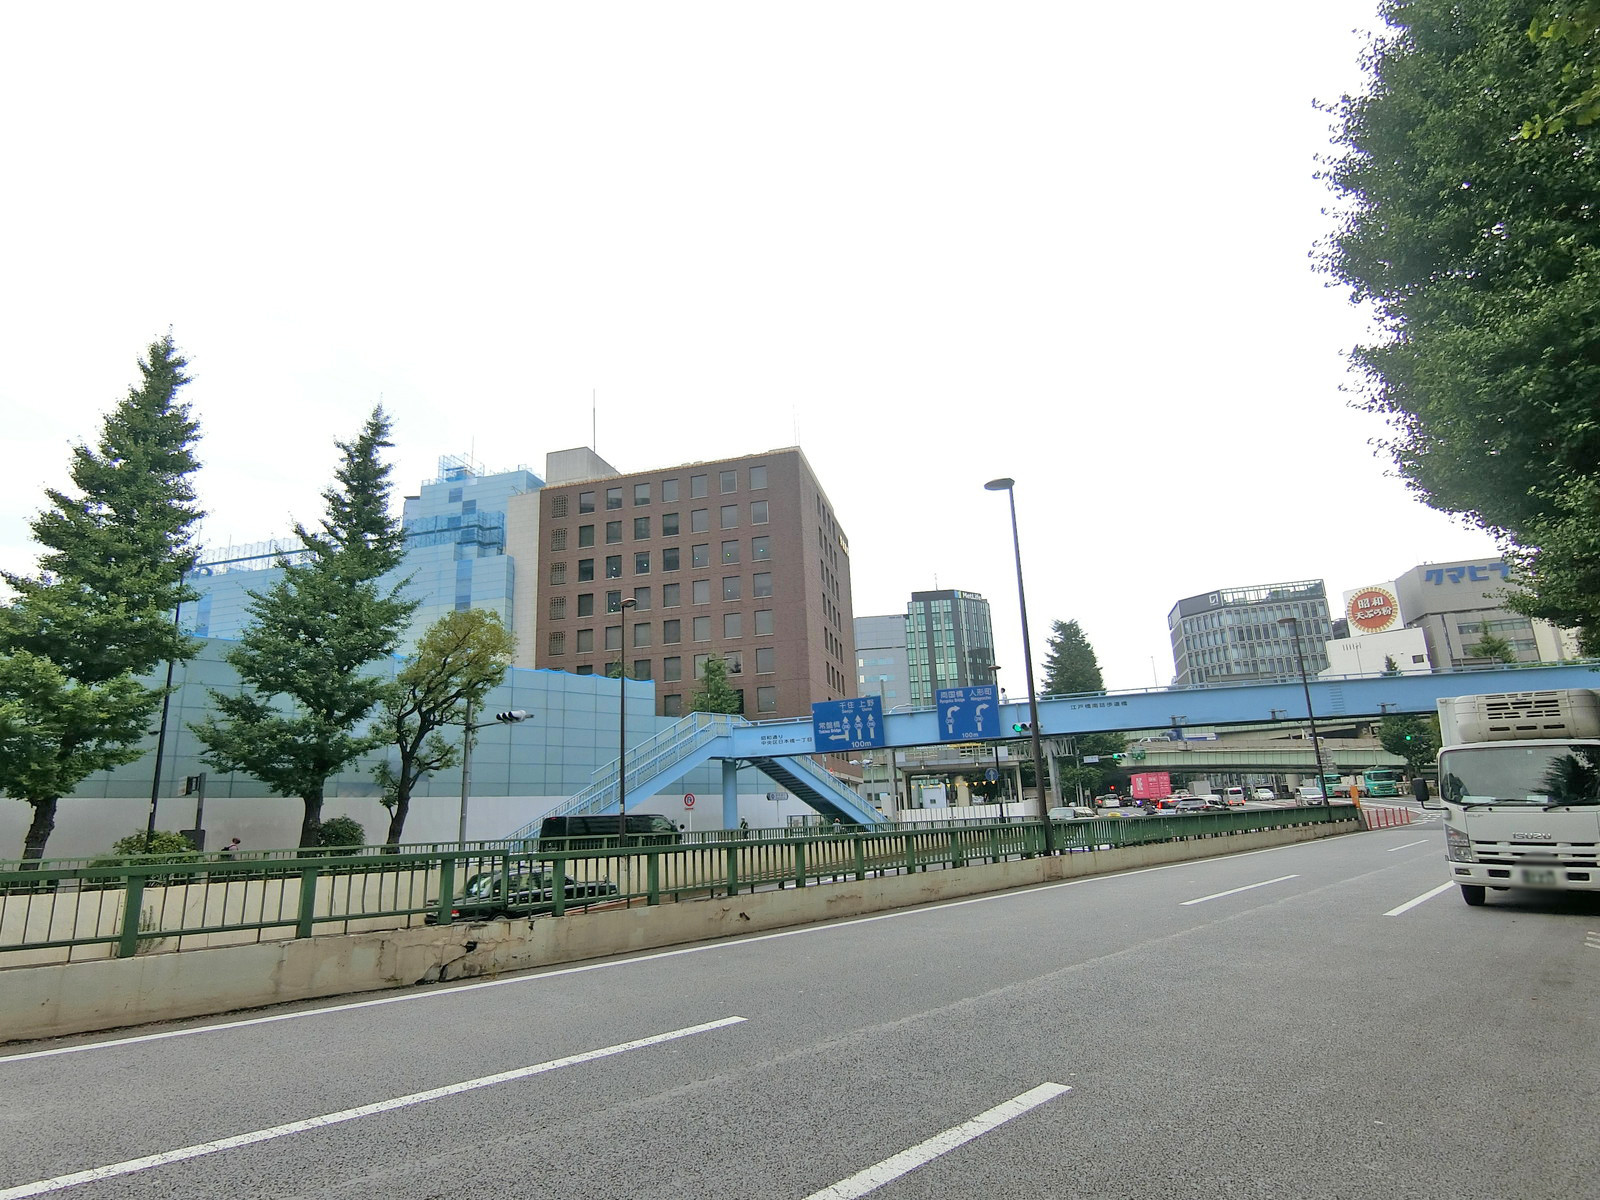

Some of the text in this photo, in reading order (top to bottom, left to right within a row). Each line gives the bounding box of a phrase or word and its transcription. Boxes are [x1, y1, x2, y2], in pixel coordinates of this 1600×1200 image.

[1357, 597, 1384, 609] 昭和
[969, 688, 992, 696] 人形町
[839, 701, 855, 709] 千住
[859, 699, 874, 708] 上野
[851, 740, 872, 748] 100m
[1512, 831, 1552, 840] ISUZU
